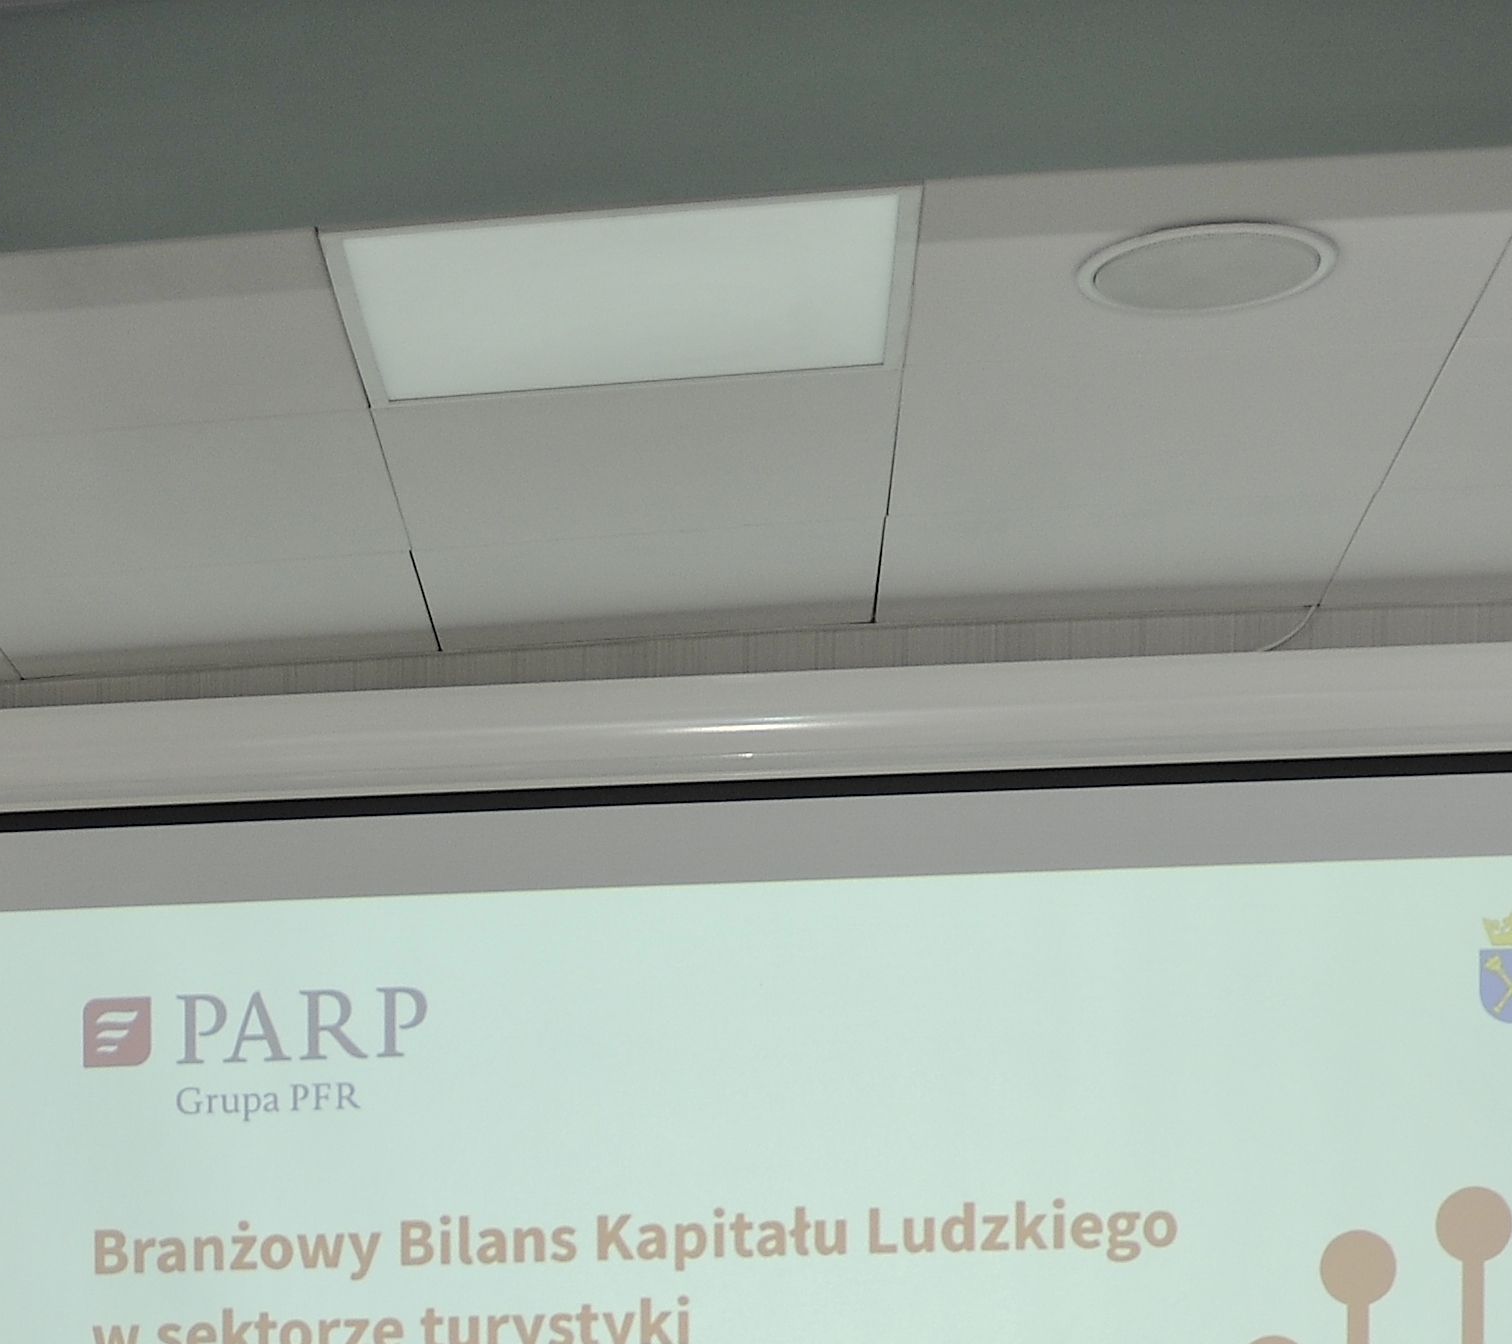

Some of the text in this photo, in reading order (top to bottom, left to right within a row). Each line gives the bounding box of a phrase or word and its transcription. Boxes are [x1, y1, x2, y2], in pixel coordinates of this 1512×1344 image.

[175, 986, 429, 1064] PARP
[175, 1081, 362, 1122] Grupa PFR
[93, 1199, 1178, 1281] Branżowy Bilans Kapitału Ludzkiego
